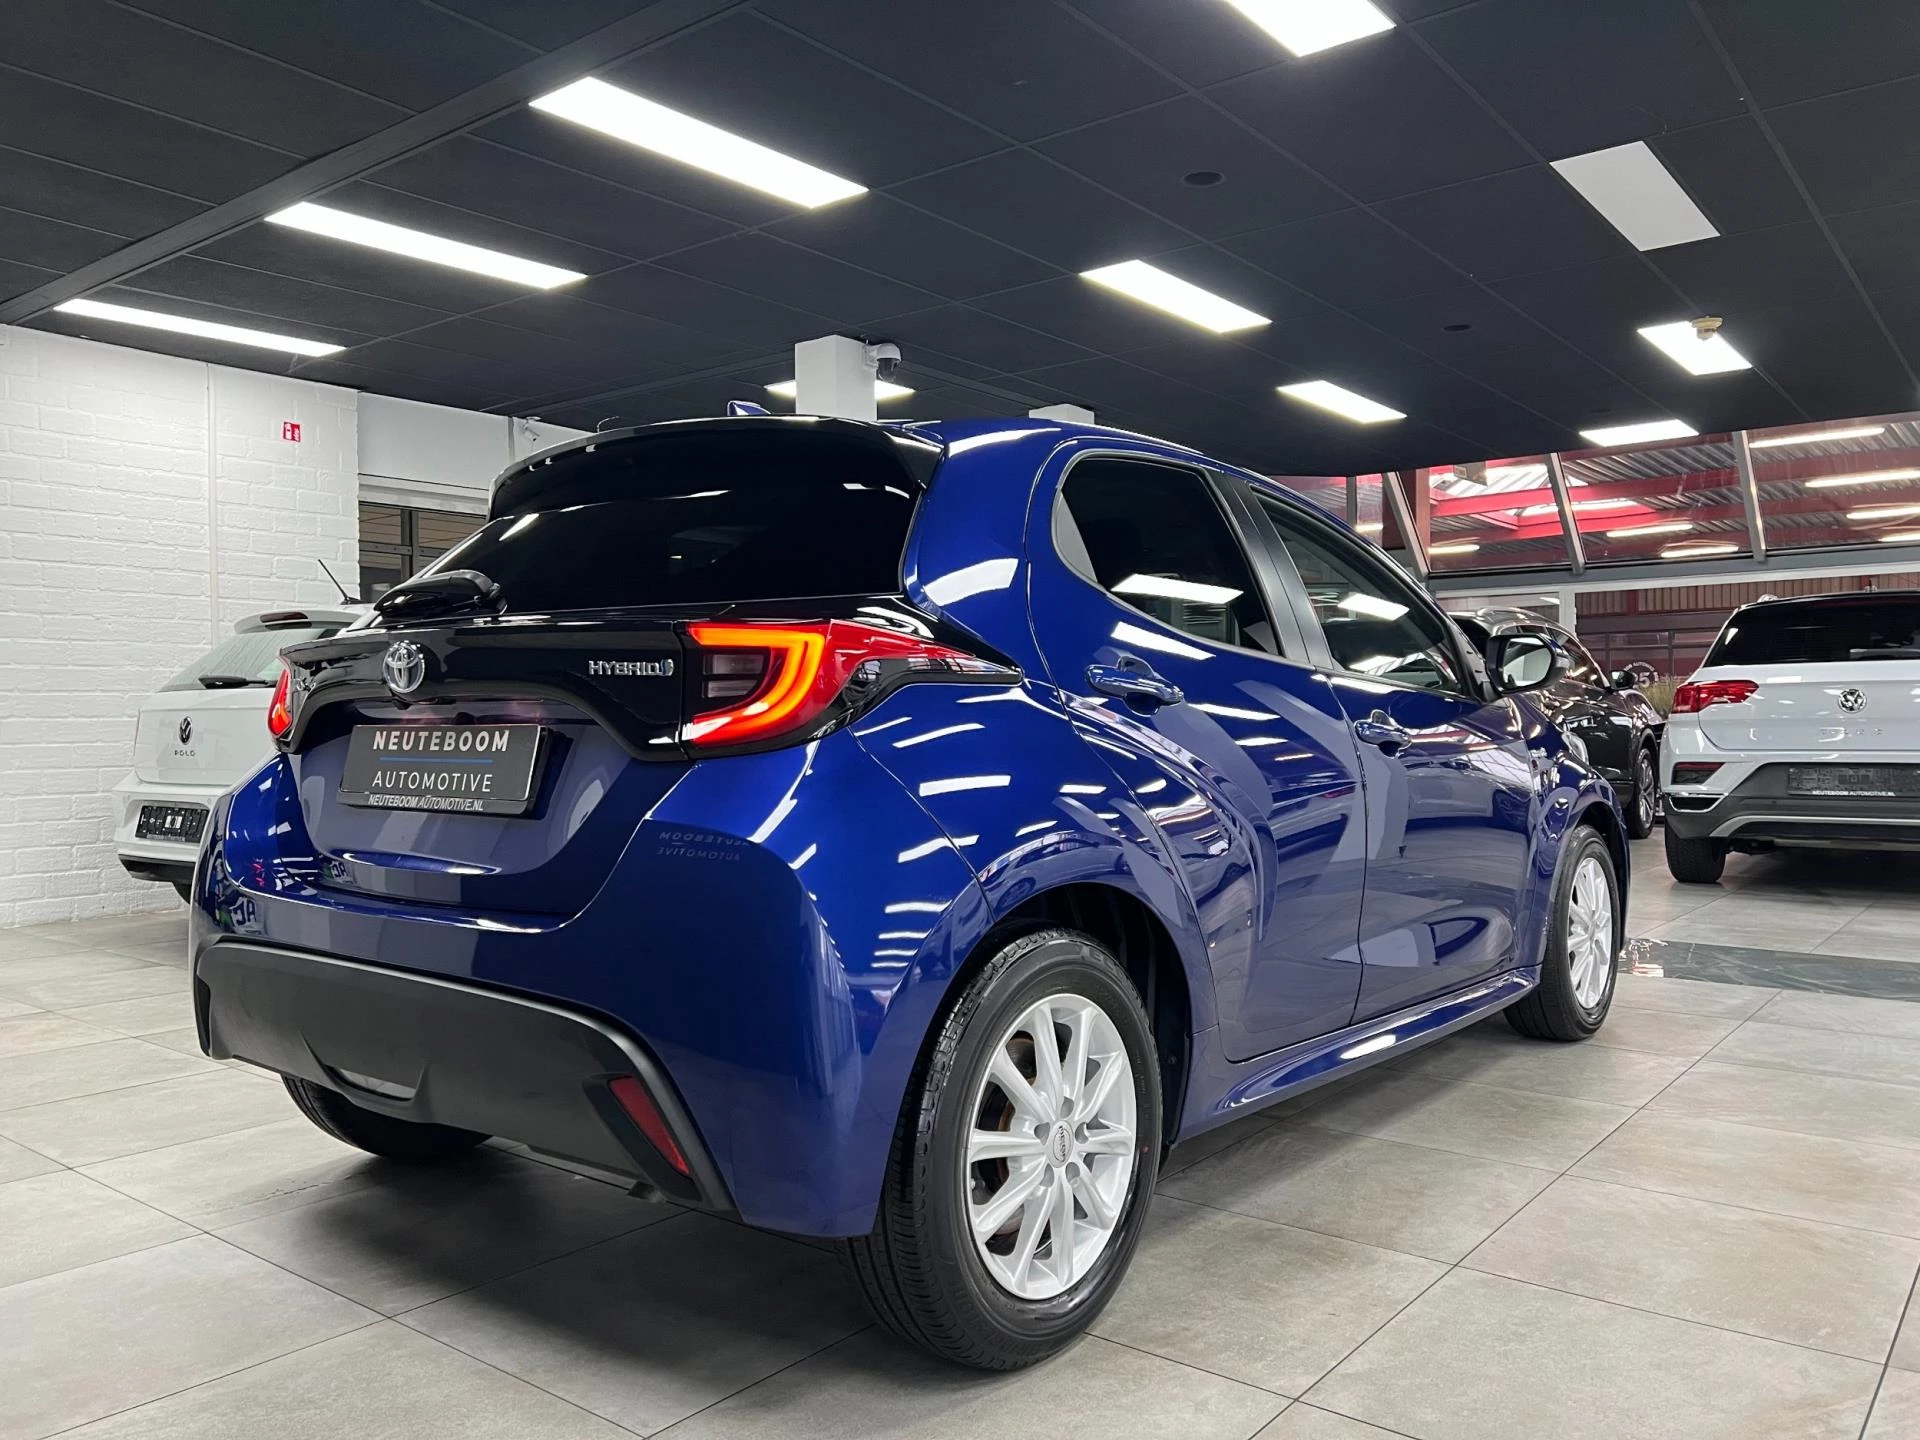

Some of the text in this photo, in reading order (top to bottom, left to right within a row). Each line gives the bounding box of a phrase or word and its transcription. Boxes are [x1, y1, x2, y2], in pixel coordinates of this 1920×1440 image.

[588, 660, 662, 676] HYBRID
[372, 730, 510, 752] NEUTEBOOM
[174, 749, 196, 757] POLO
[372, 771, 493, 793] AUTOMOTIVE
